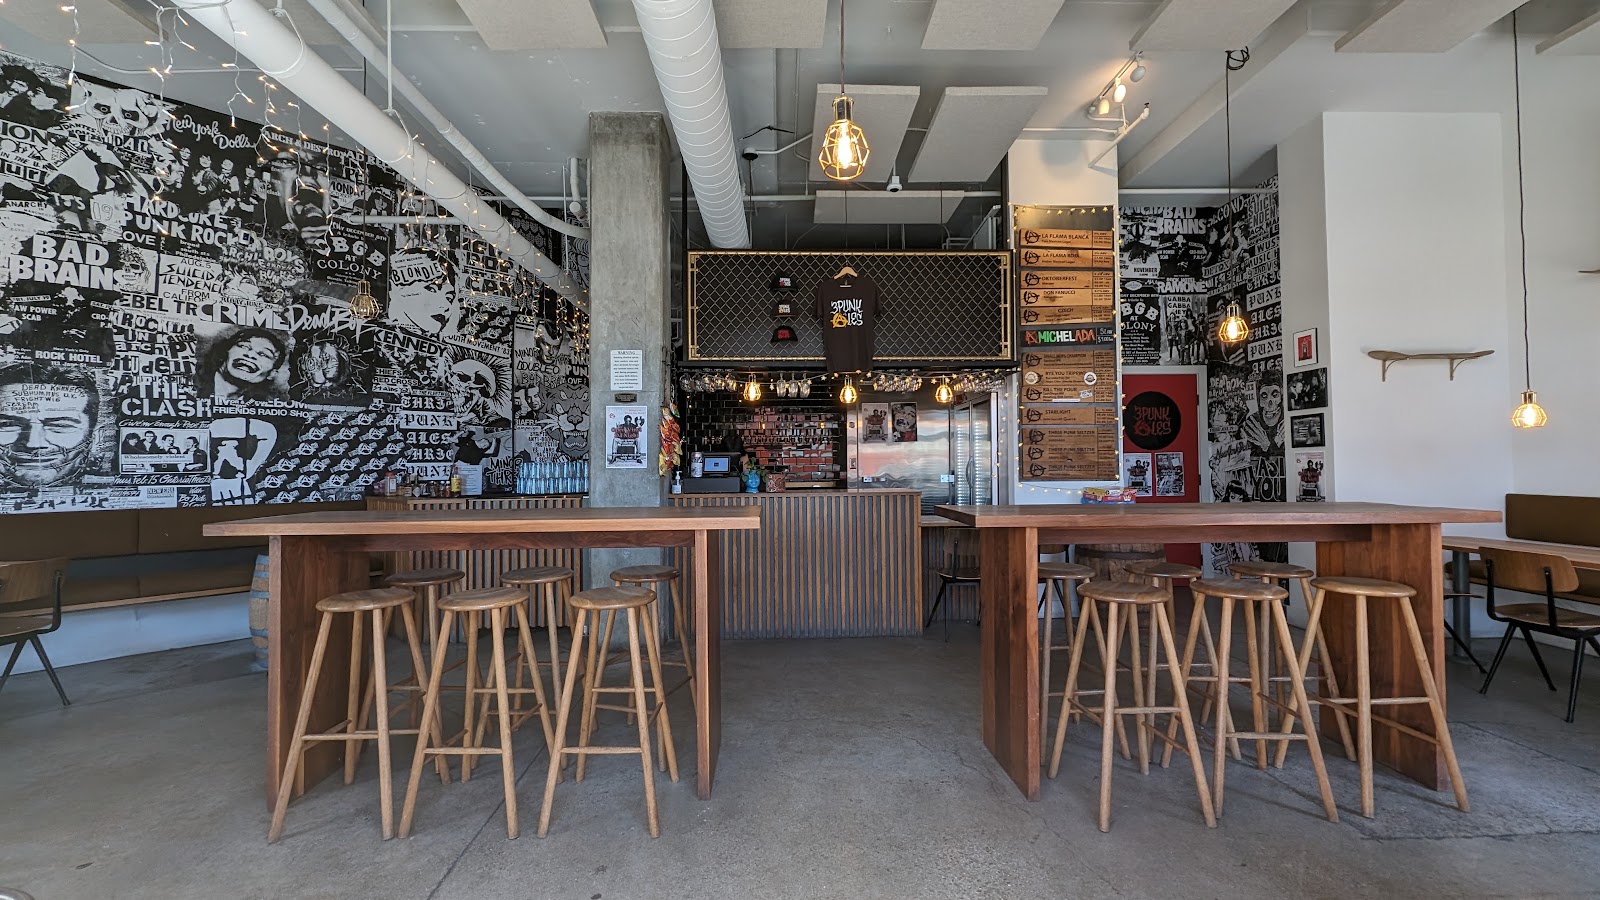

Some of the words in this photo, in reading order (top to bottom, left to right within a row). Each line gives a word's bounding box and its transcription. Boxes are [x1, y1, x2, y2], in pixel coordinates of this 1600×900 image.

[213, 134, 256, 150] Dolls
[1163, 206, 1197, 219] BAD
[120, 210, 187, 240] PUNK
[191, 225, 240, 248] ROCK
[122, 230, 156, 246] OVE
[32, 234, 110, 267] BAD
[345, 254, 358, 262] AT
[316, 259, 382, 280] COLONY
[391, 262, 441, 283] BLONDIE
[30, 306, 57, 316] POWER
[121, 293, 168, 313] EBEL
[1120, 301, 1159, 321] BGB
[21, 313, 42, 321] SCAB
[199, 302, 289, 331] CRIME
[1120, 321, 1157, 332] OLONY
[373, 326, 447, 357] KENNEDY
[1038, 328, 1095, 344] MICHELADA
[35, 350, 65, 361] ROCK
[69, 353, 103, 363] HOTEL
[121, 398, 212, 418] CLASH
[212, 406, 256, 415] FRIENDS
[257, 408, 288, 417] RADIO
[404, 413, 454, 428] PUNK
